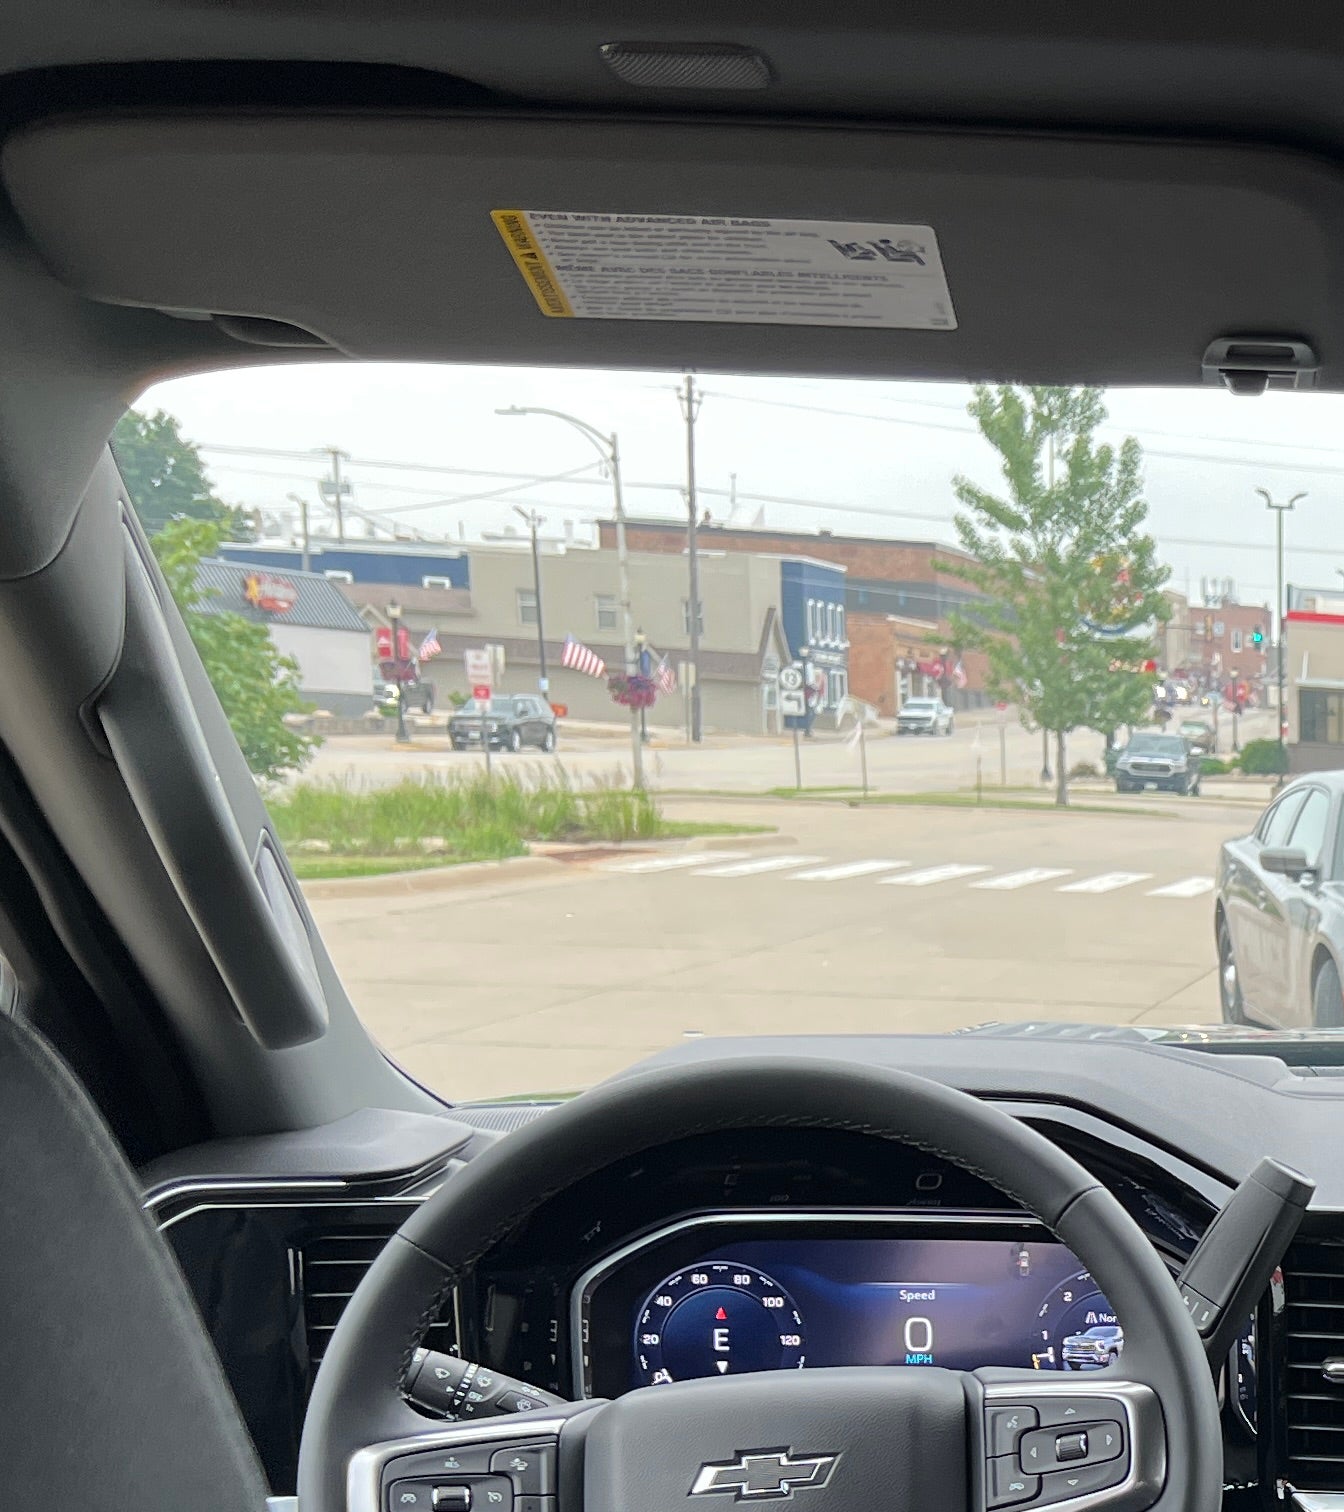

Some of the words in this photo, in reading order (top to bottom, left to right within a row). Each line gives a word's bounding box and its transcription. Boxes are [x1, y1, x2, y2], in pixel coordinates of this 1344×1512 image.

[691, 1274, 708, 1284] 60
[733, 1274, 751, 1285] 80
[655, 1295, 672, 1307] 40
[899, 1290, 935, 1302] Speed
[1063, 1291, 1072, 1301] 2
[762, 1296, 784, 1308] 100
[643, 1334, 659, 1345] 20
[713, 1328, 730, 1351] E
[904, 1317, 933, 1352] 0
[780, 1335, 801, 1346] 120
[906, 1354, 932, 1364] MPH
